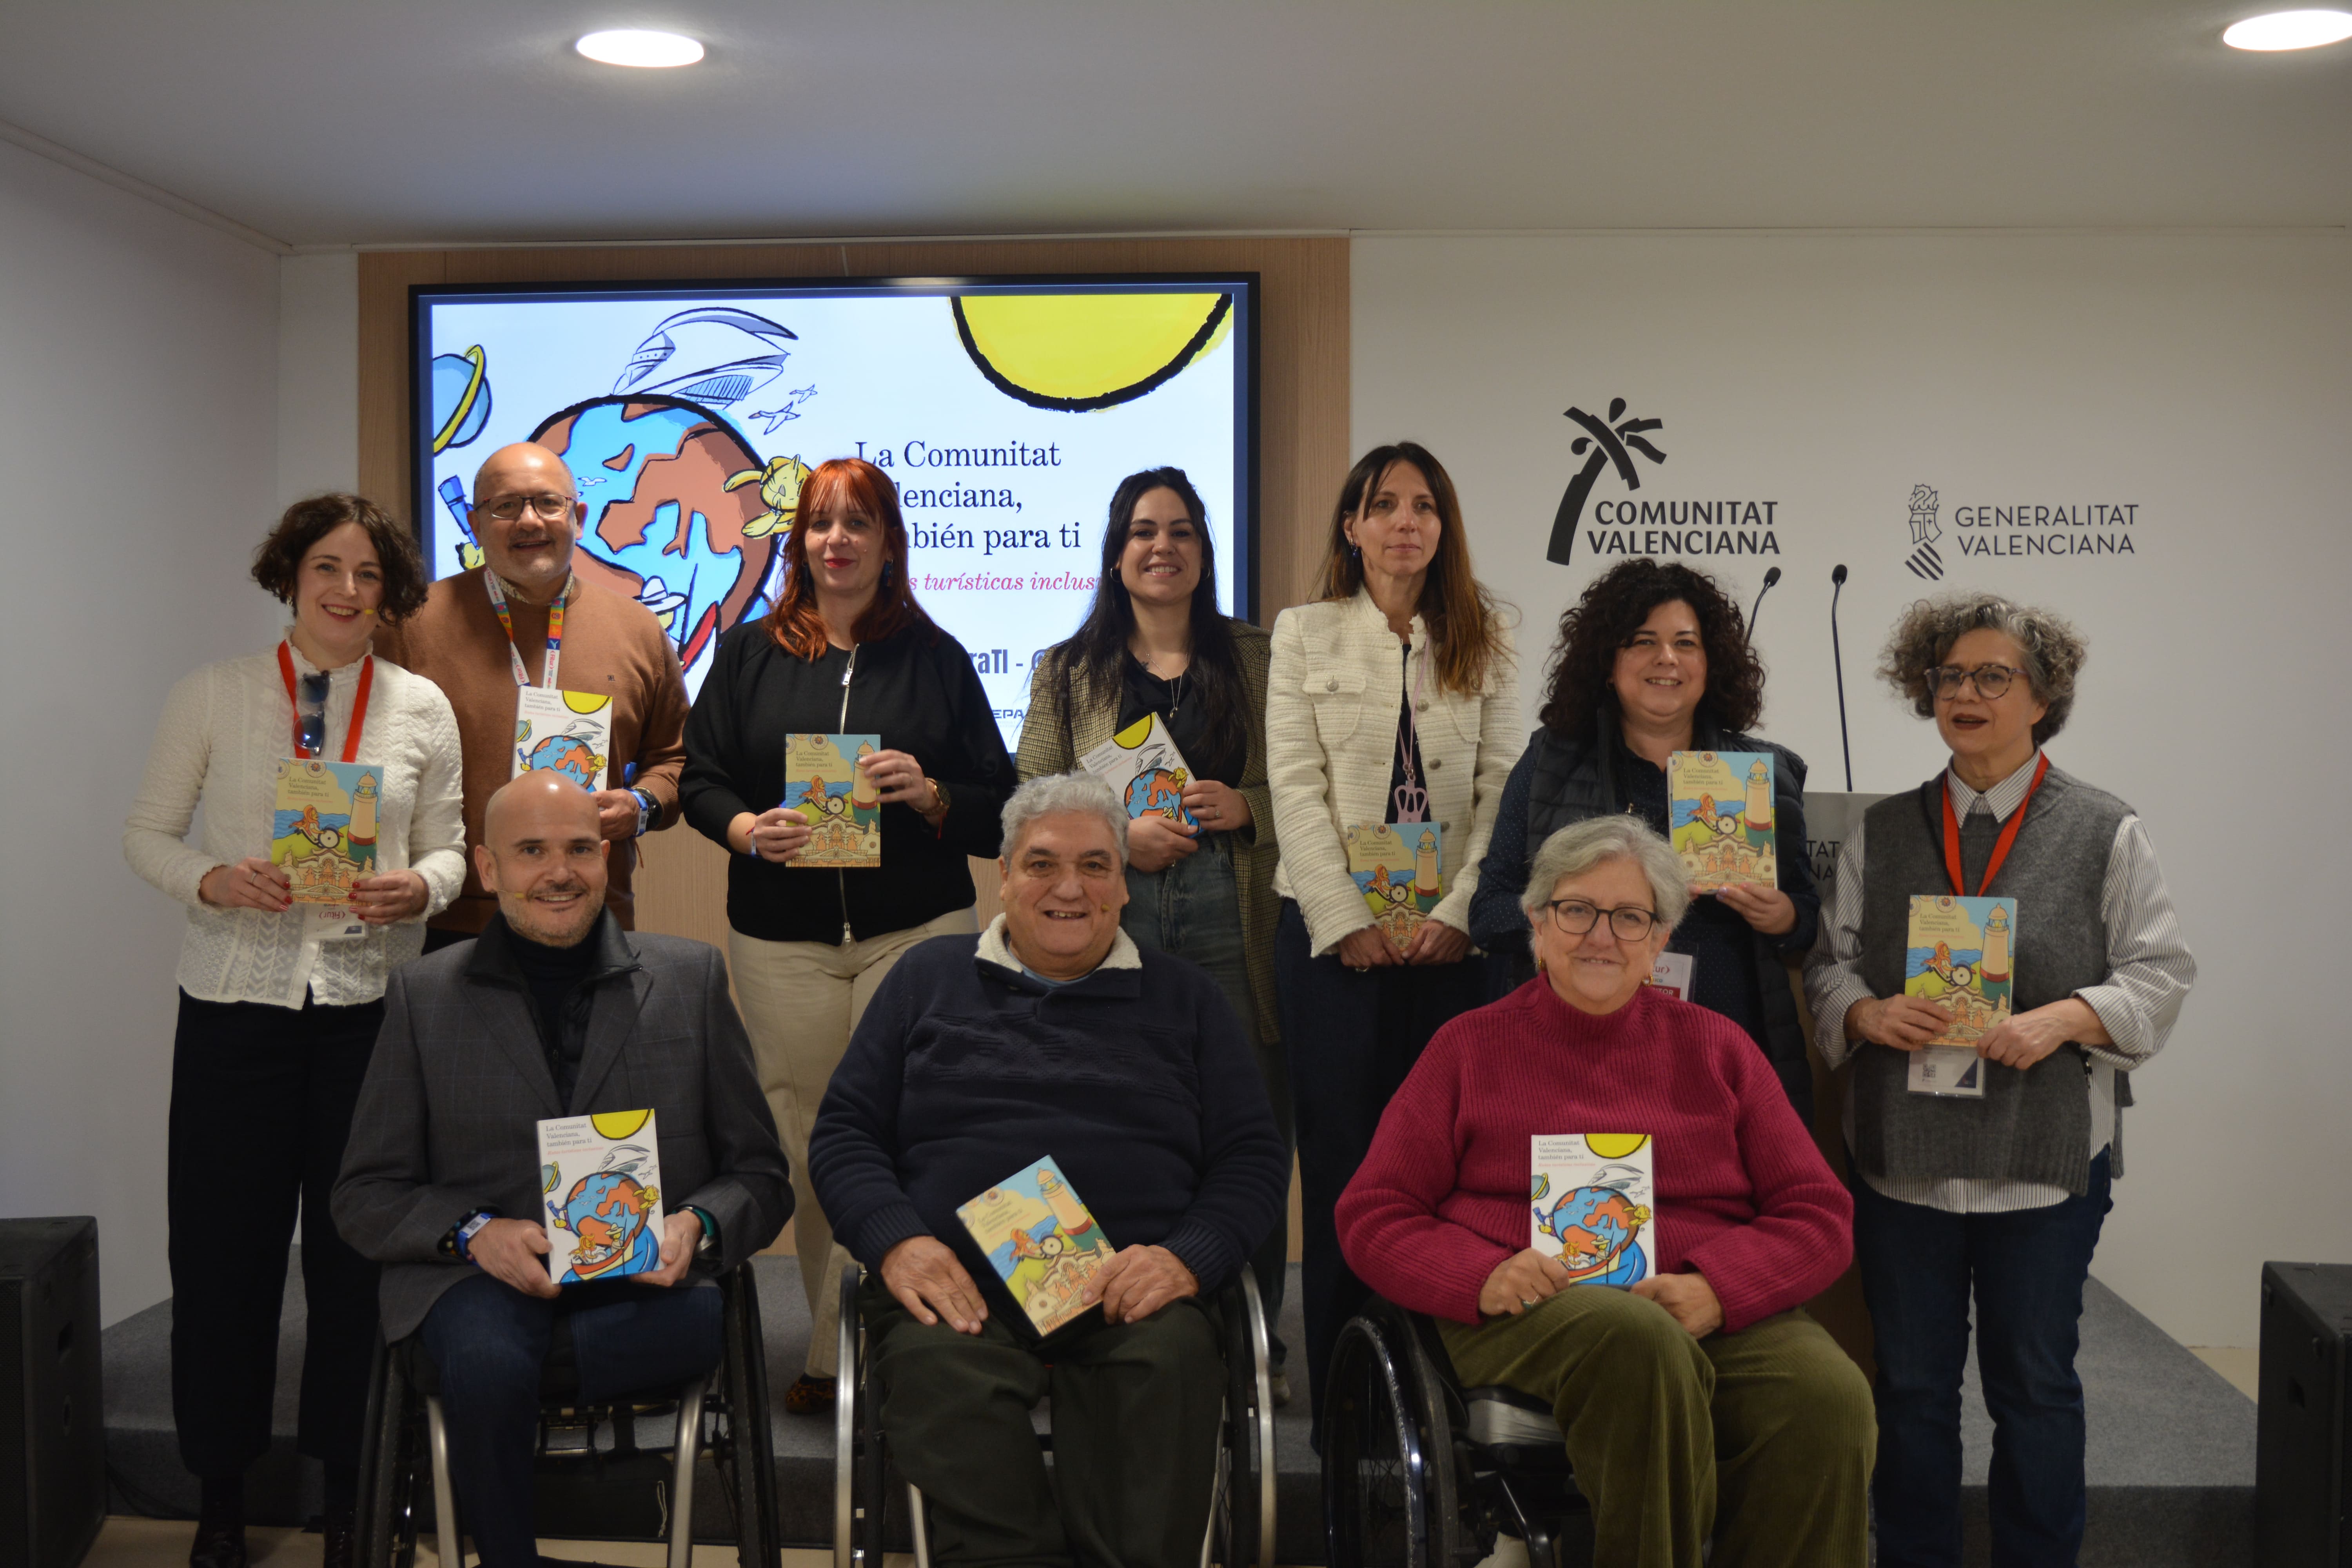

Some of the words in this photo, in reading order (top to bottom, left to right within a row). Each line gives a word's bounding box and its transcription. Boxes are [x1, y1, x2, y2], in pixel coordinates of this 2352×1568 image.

[855, 441, 895, 467] La
[904, 440, 1062, 467] Comunitat
[894, 482, 1022, 513] lenciana,
[1595, 501, 1778, 525] COMUNITAT
[1955, 505, 2139, 527] GENERALITAT
[906, 522, 974, 548] bién
[983, 528, 1051, 555] para
[1058, 522, 1081, 548] ti
[1587, 530, 1780, 555] VALENCIANA
[1958, 534, 2135, 556] VALENCIANA
[924, 571, 1024, 591] turísticas
[992, 709, 1025, 719] EPA
